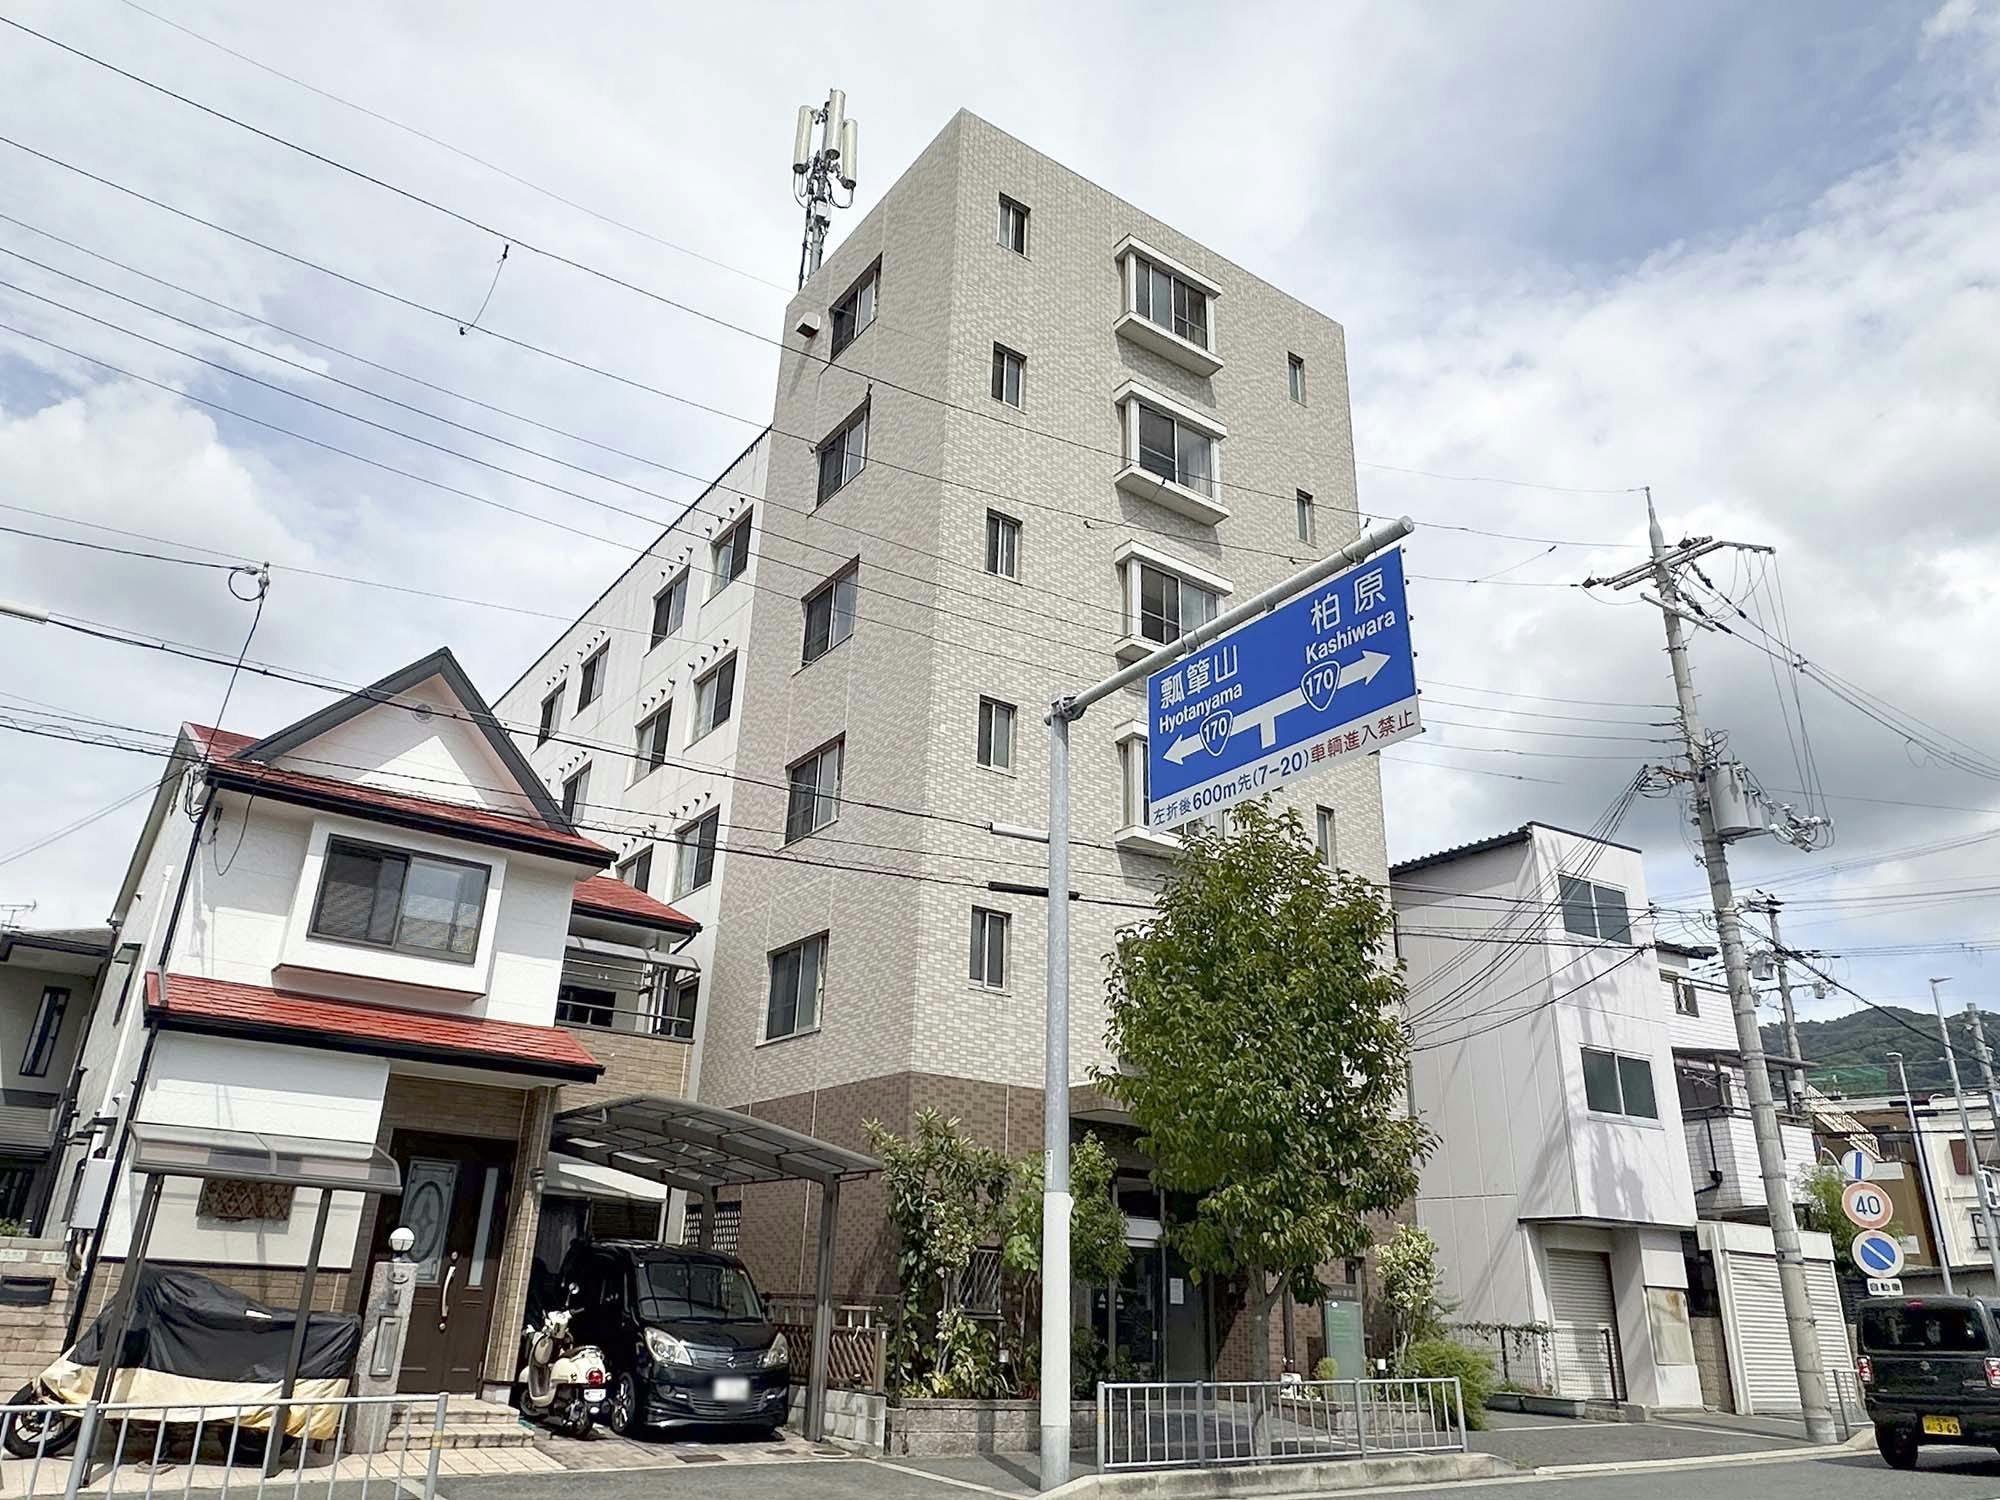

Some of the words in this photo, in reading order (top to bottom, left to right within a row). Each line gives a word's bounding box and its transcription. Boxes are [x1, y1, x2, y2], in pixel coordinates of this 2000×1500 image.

[1310, 567, 1386, 635] 柏原
[1305, 610, 1396, 664] Kashiwara
[1305, 669, 1334, 697] 170
[1159, 683, 1243, 734] Hyotanyama
[1203, 717, 1228, 743] 170
[1856, 1195, 1881, 1216] 40
